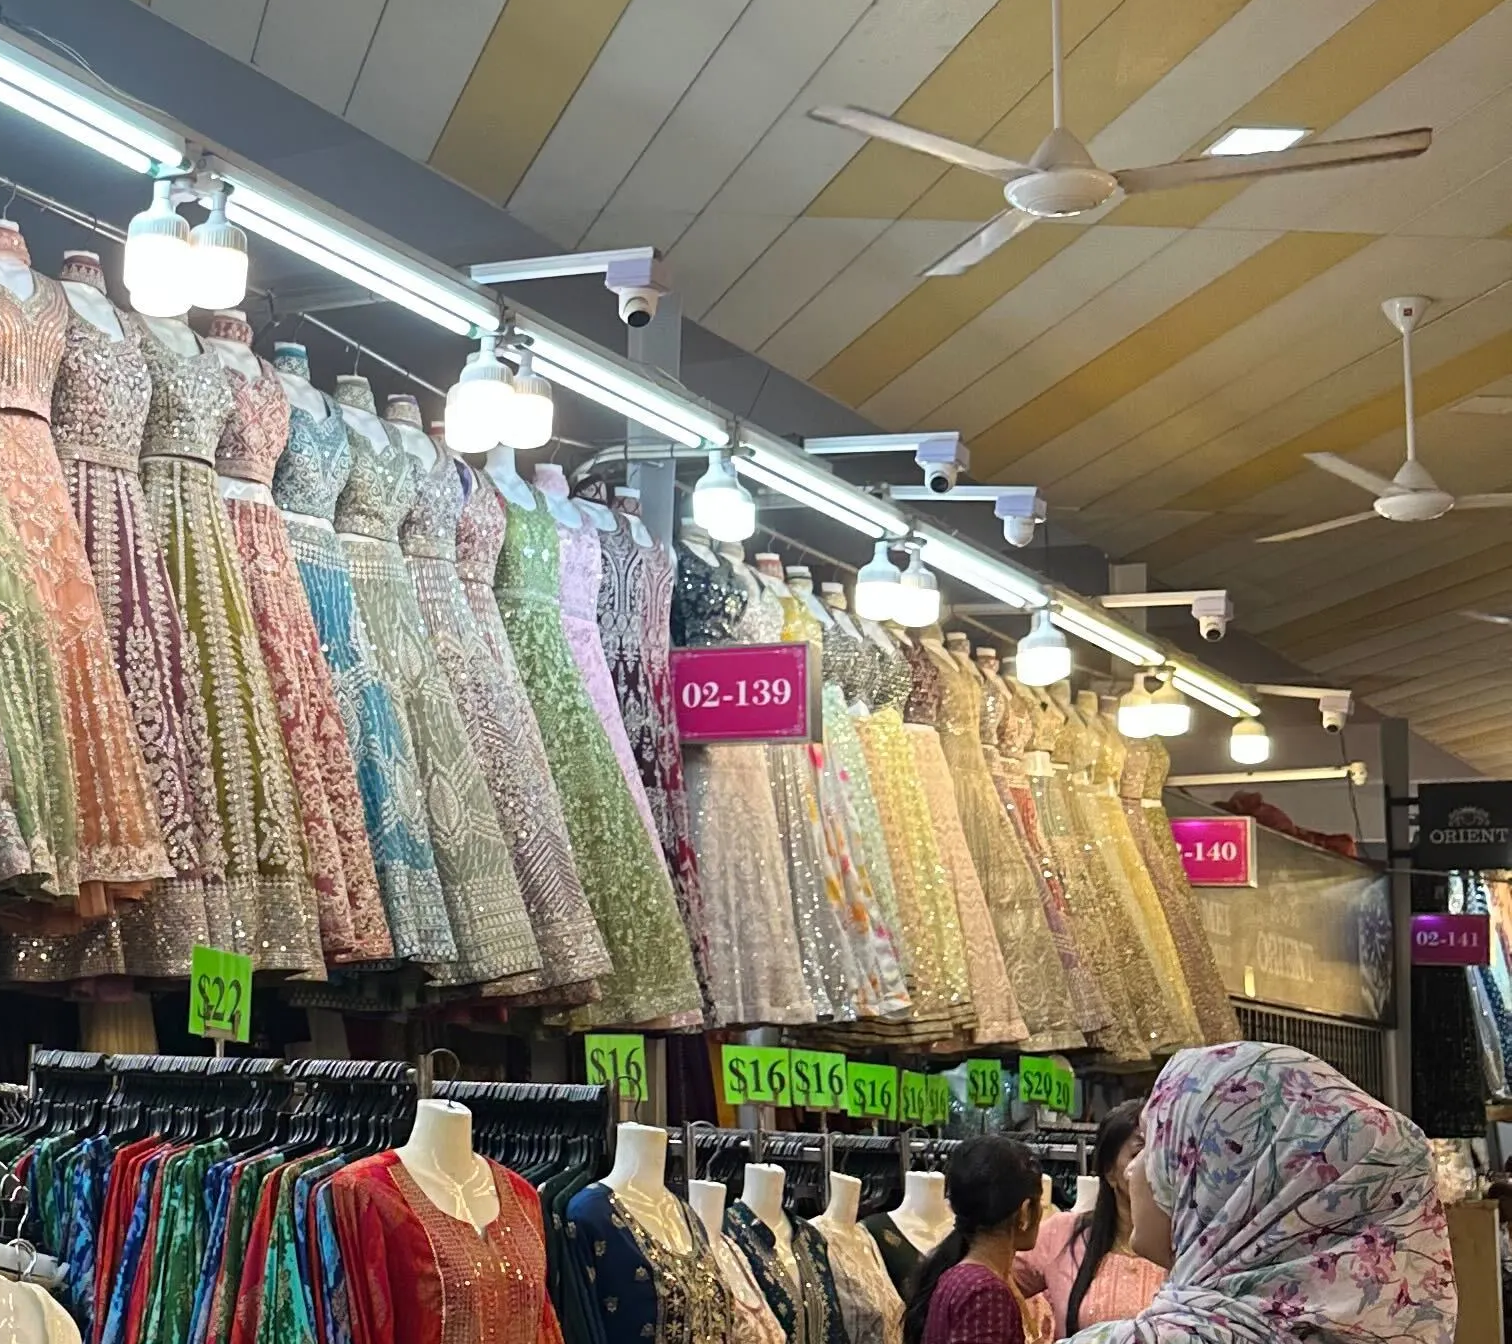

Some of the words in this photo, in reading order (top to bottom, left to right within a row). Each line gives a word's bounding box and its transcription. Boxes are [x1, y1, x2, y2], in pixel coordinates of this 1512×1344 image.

[682, 678, 791, 708] 02-139
[1429, 827, 1509, 844] ORIENT
[1416, 931, 1479, 947] 02-141
[197, 974, 242, 1023] $22
[590, 1047, 642, 1089] $16
[729, 1057, 786, 1094] $16
[795, 1059, 844, 1096] $16
[853, 1078, 892, 1109] $16
[902, 1085, 925, 1115] $16
[969, 1069, 1000, 1102] $18
[1023, 1070, 1052, 1100] $20
